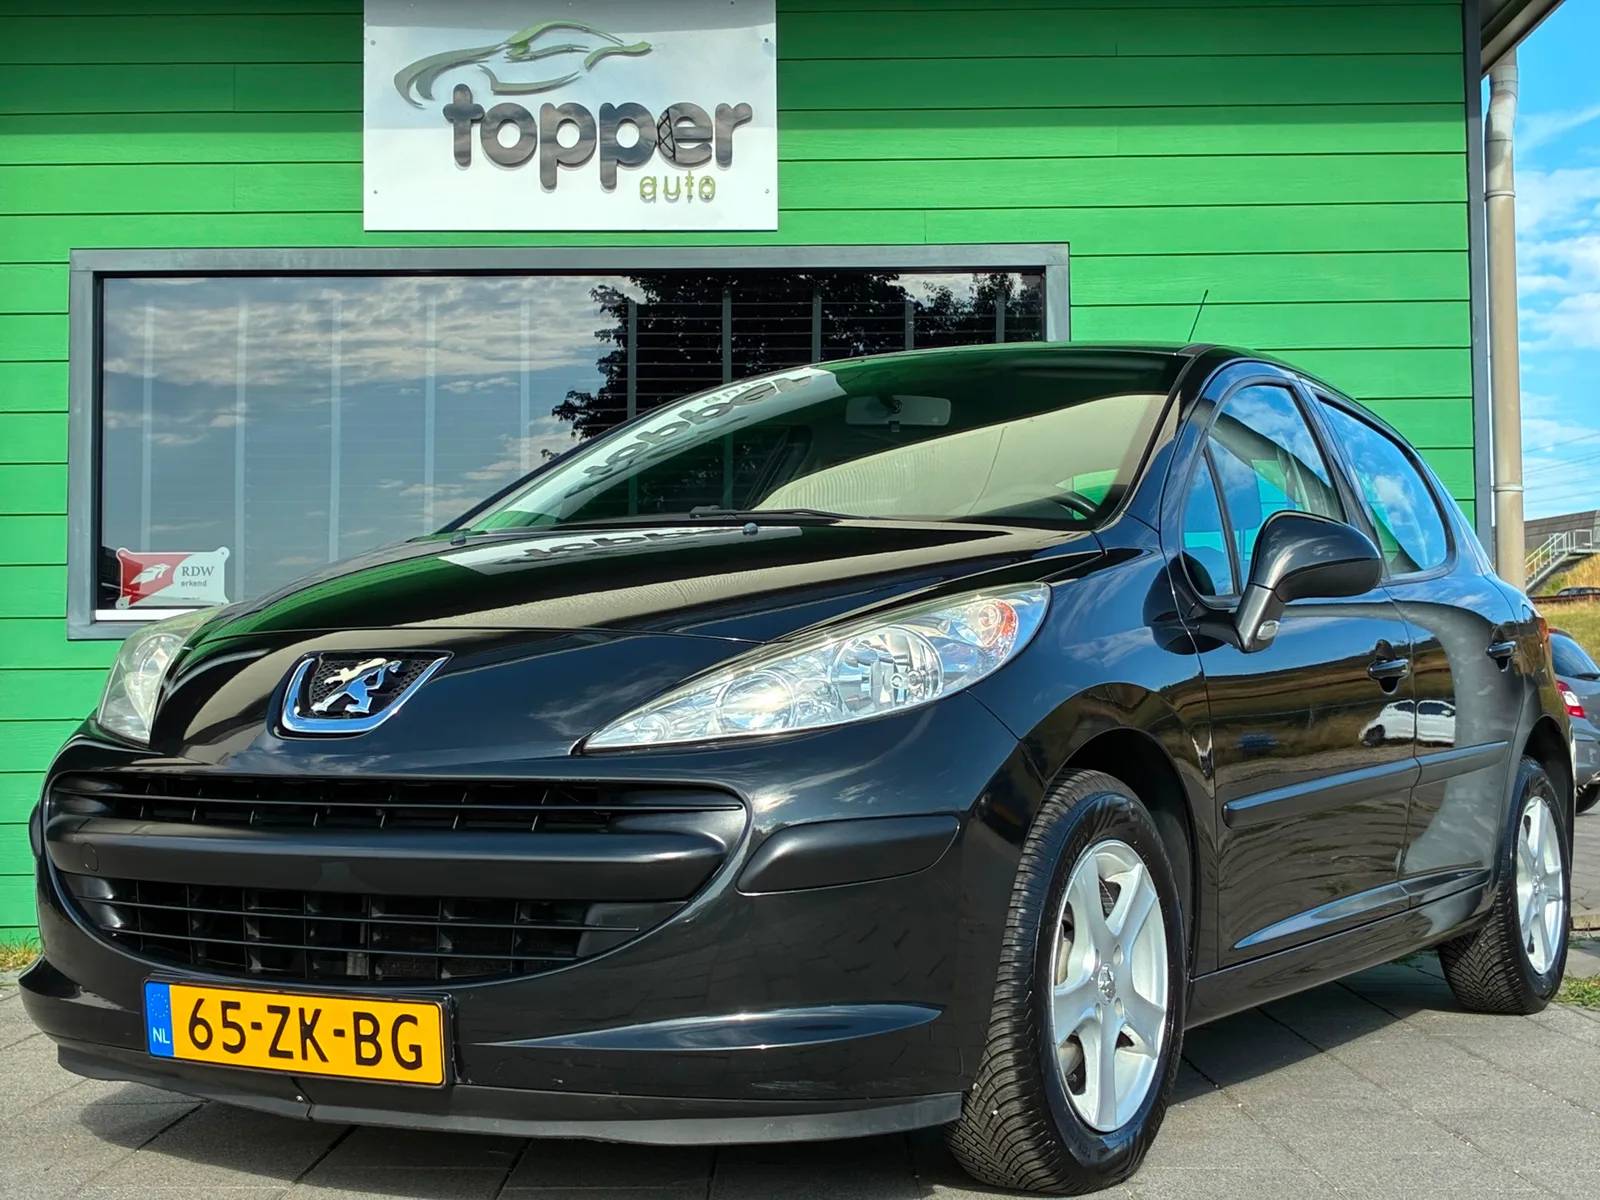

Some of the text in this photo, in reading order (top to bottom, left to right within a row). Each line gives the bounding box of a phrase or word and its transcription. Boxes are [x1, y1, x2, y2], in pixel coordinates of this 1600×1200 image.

[442, 83, 753, 192] topper
[639, 170, 717, 202] auto
[181, 565, 215, 577] RDW
[181, 579, 207, 587] erkend
[152, 1026, 171, 1045] NL
[188, 997, 423, 1071] 65-ZK-BG
